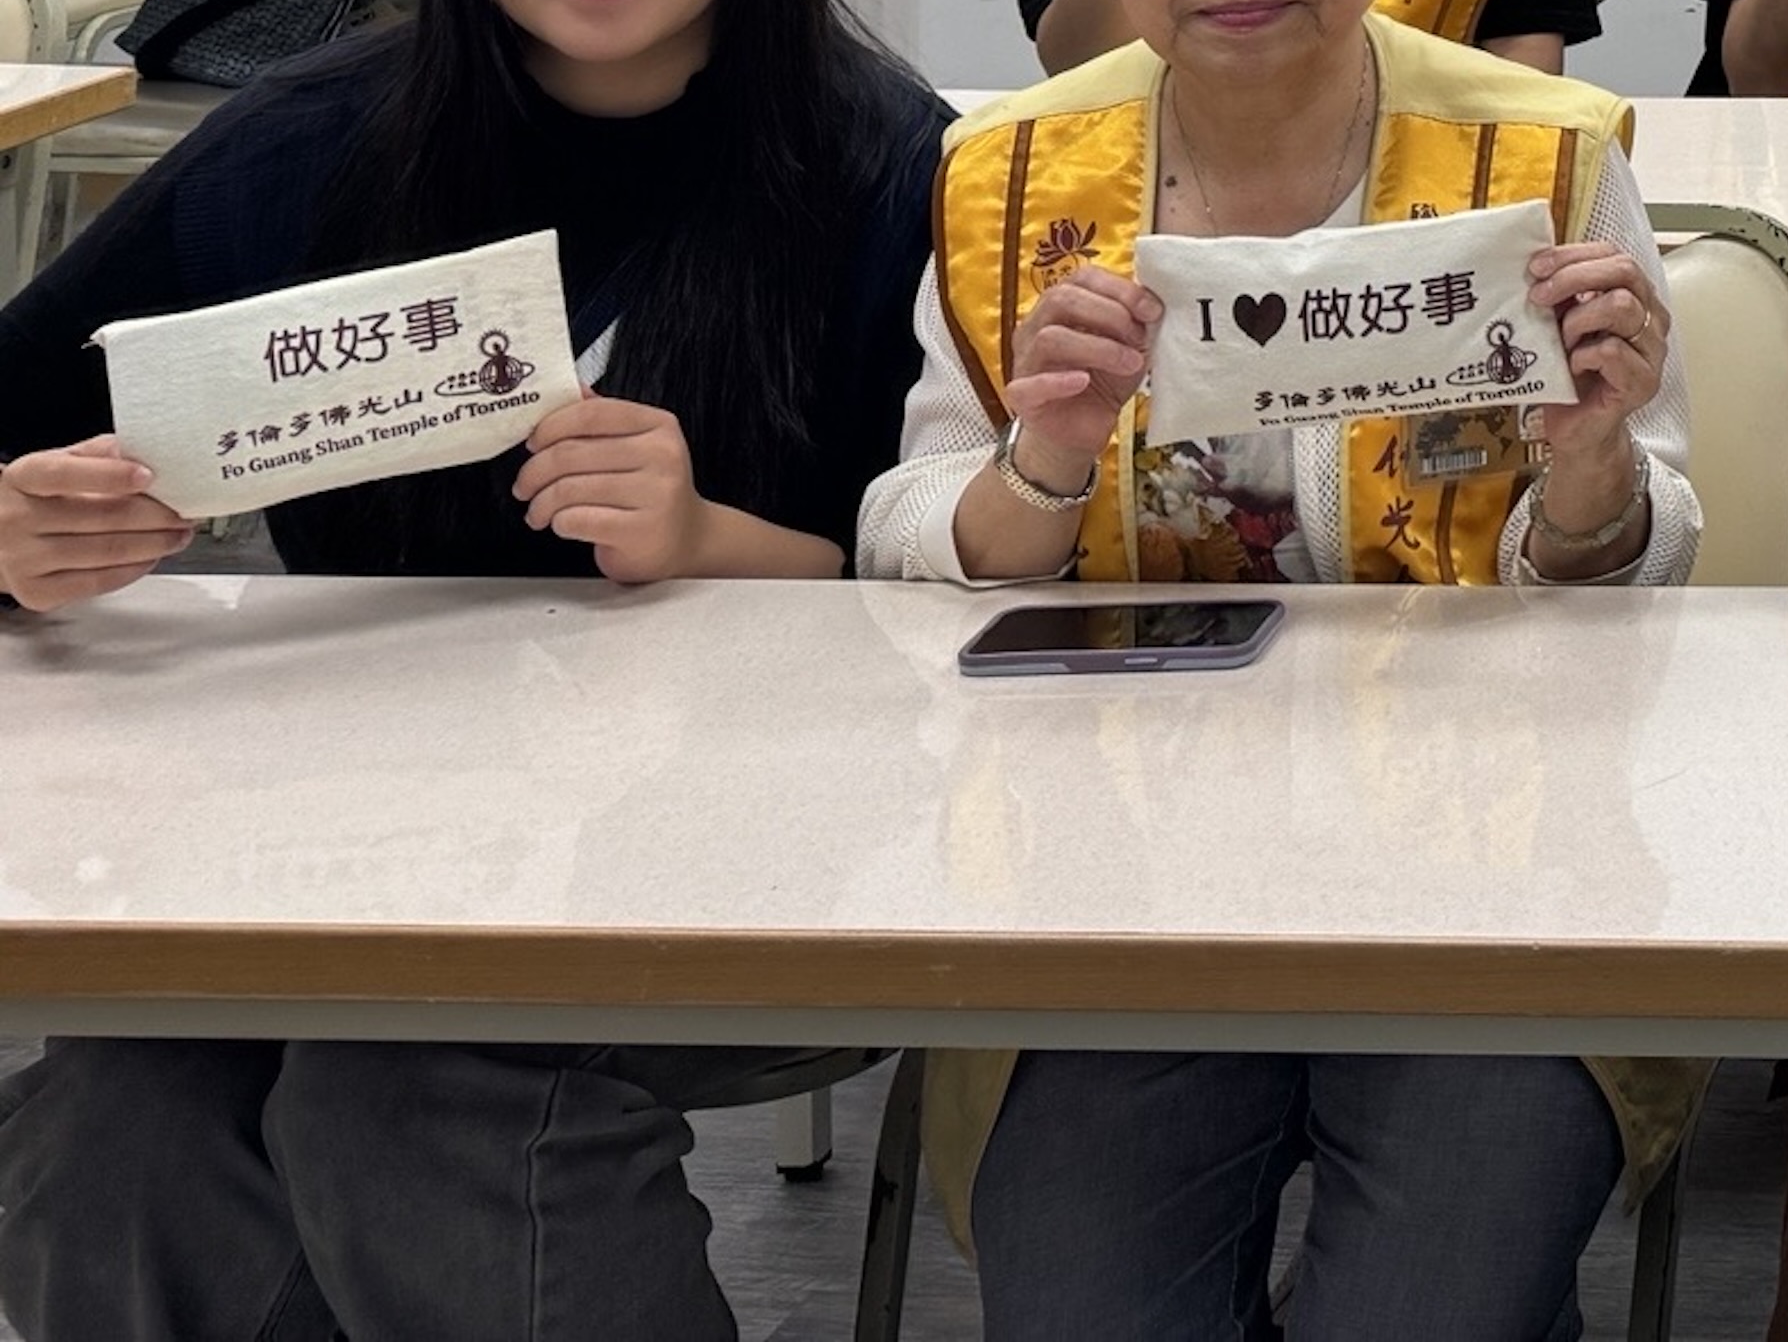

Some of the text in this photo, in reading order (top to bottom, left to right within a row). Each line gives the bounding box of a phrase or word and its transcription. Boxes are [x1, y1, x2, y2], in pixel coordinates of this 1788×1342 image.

[263, 296, 463, 383] 做好事
[1196, 270, 1479, 343] I 做好事
[215, 389, 423, 456] 多倫多佛光山
[1253, 375, 1437, 412] 多倫多佛光山
[1387, 395, 1451, 418] Temple
[1455, 390, 1472, 405] of
[1474, 379, 1545, 402] Toronto
[221, 390, 541, 480] Fo Guang Shan Temple of Toronto
